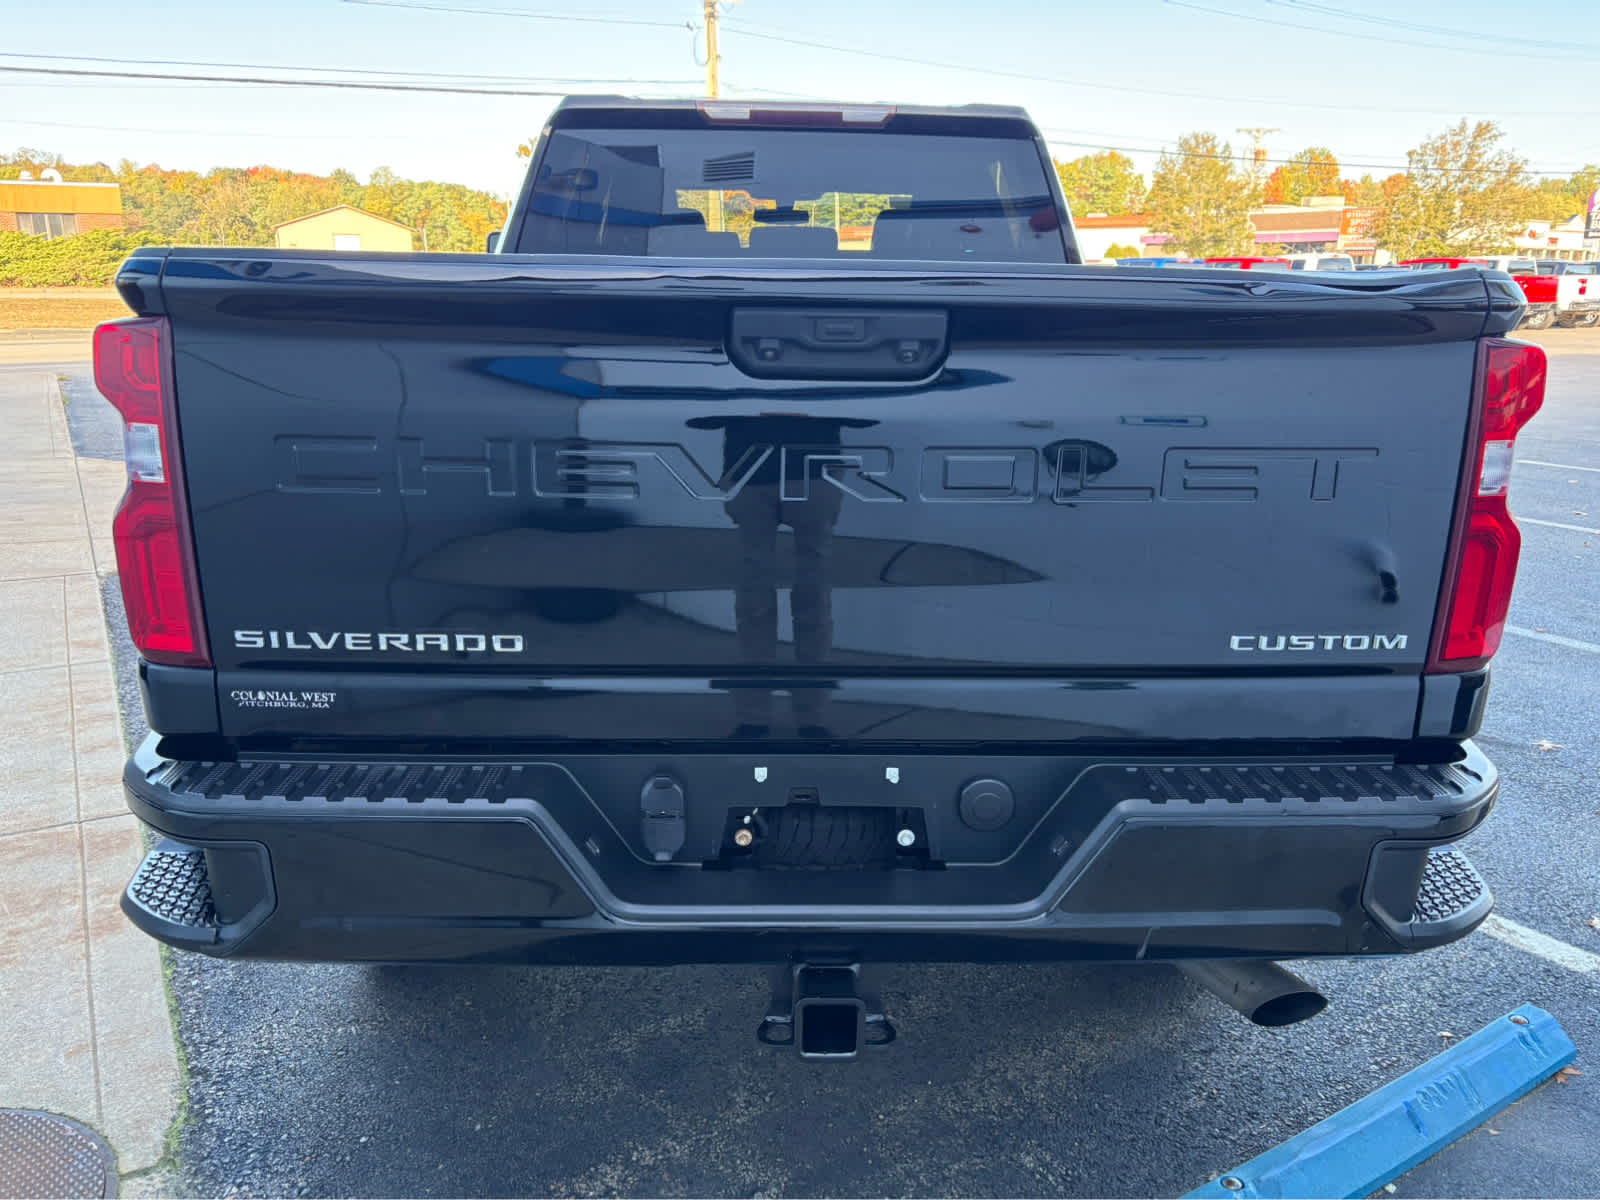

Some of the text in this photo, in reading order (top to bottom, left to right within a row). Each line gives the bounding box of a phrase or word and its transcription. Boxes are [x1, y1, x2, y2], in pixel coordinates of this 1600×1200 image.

[274, 434, 1379, 504] CHEVROLET
[234, 629, 525, 653] SILVERADO
[1230, 634, 1409, 651] CUSTOM
[230, 690, 337, 703] COLONIAL WEST
